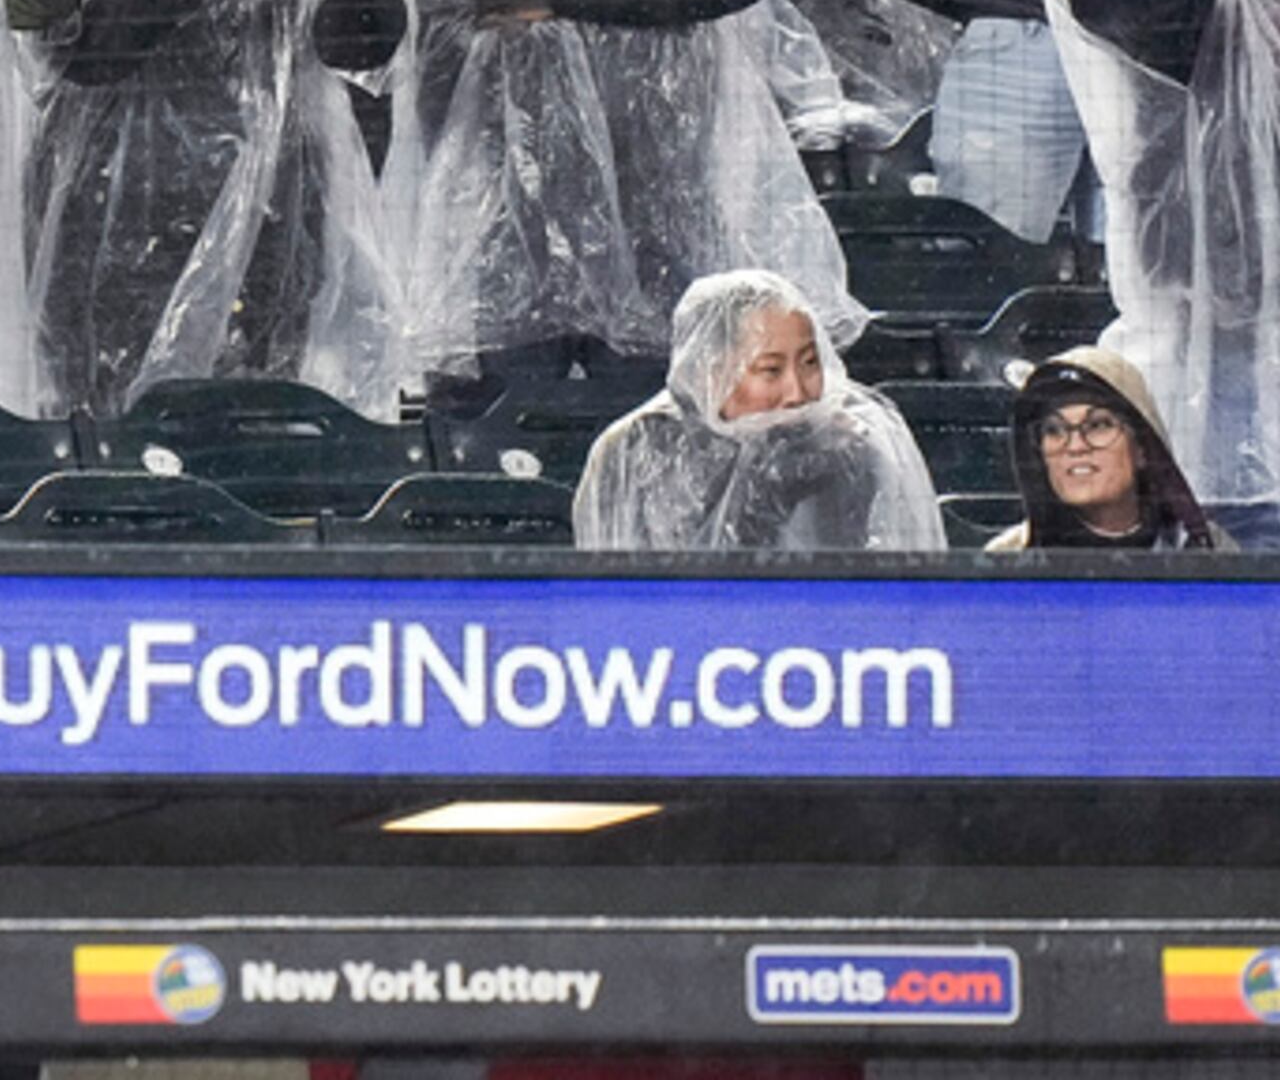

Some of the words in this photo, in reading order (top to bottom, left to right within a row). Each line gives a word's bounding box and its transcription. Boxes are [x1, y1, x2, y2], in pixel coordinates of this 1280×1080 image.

[240, 960, 339, 1003] New
[341, 959, 441, 1003] York
[444, 961, 601, 1011] Lottery
[764, 963, 1003, 1004] mets.com
